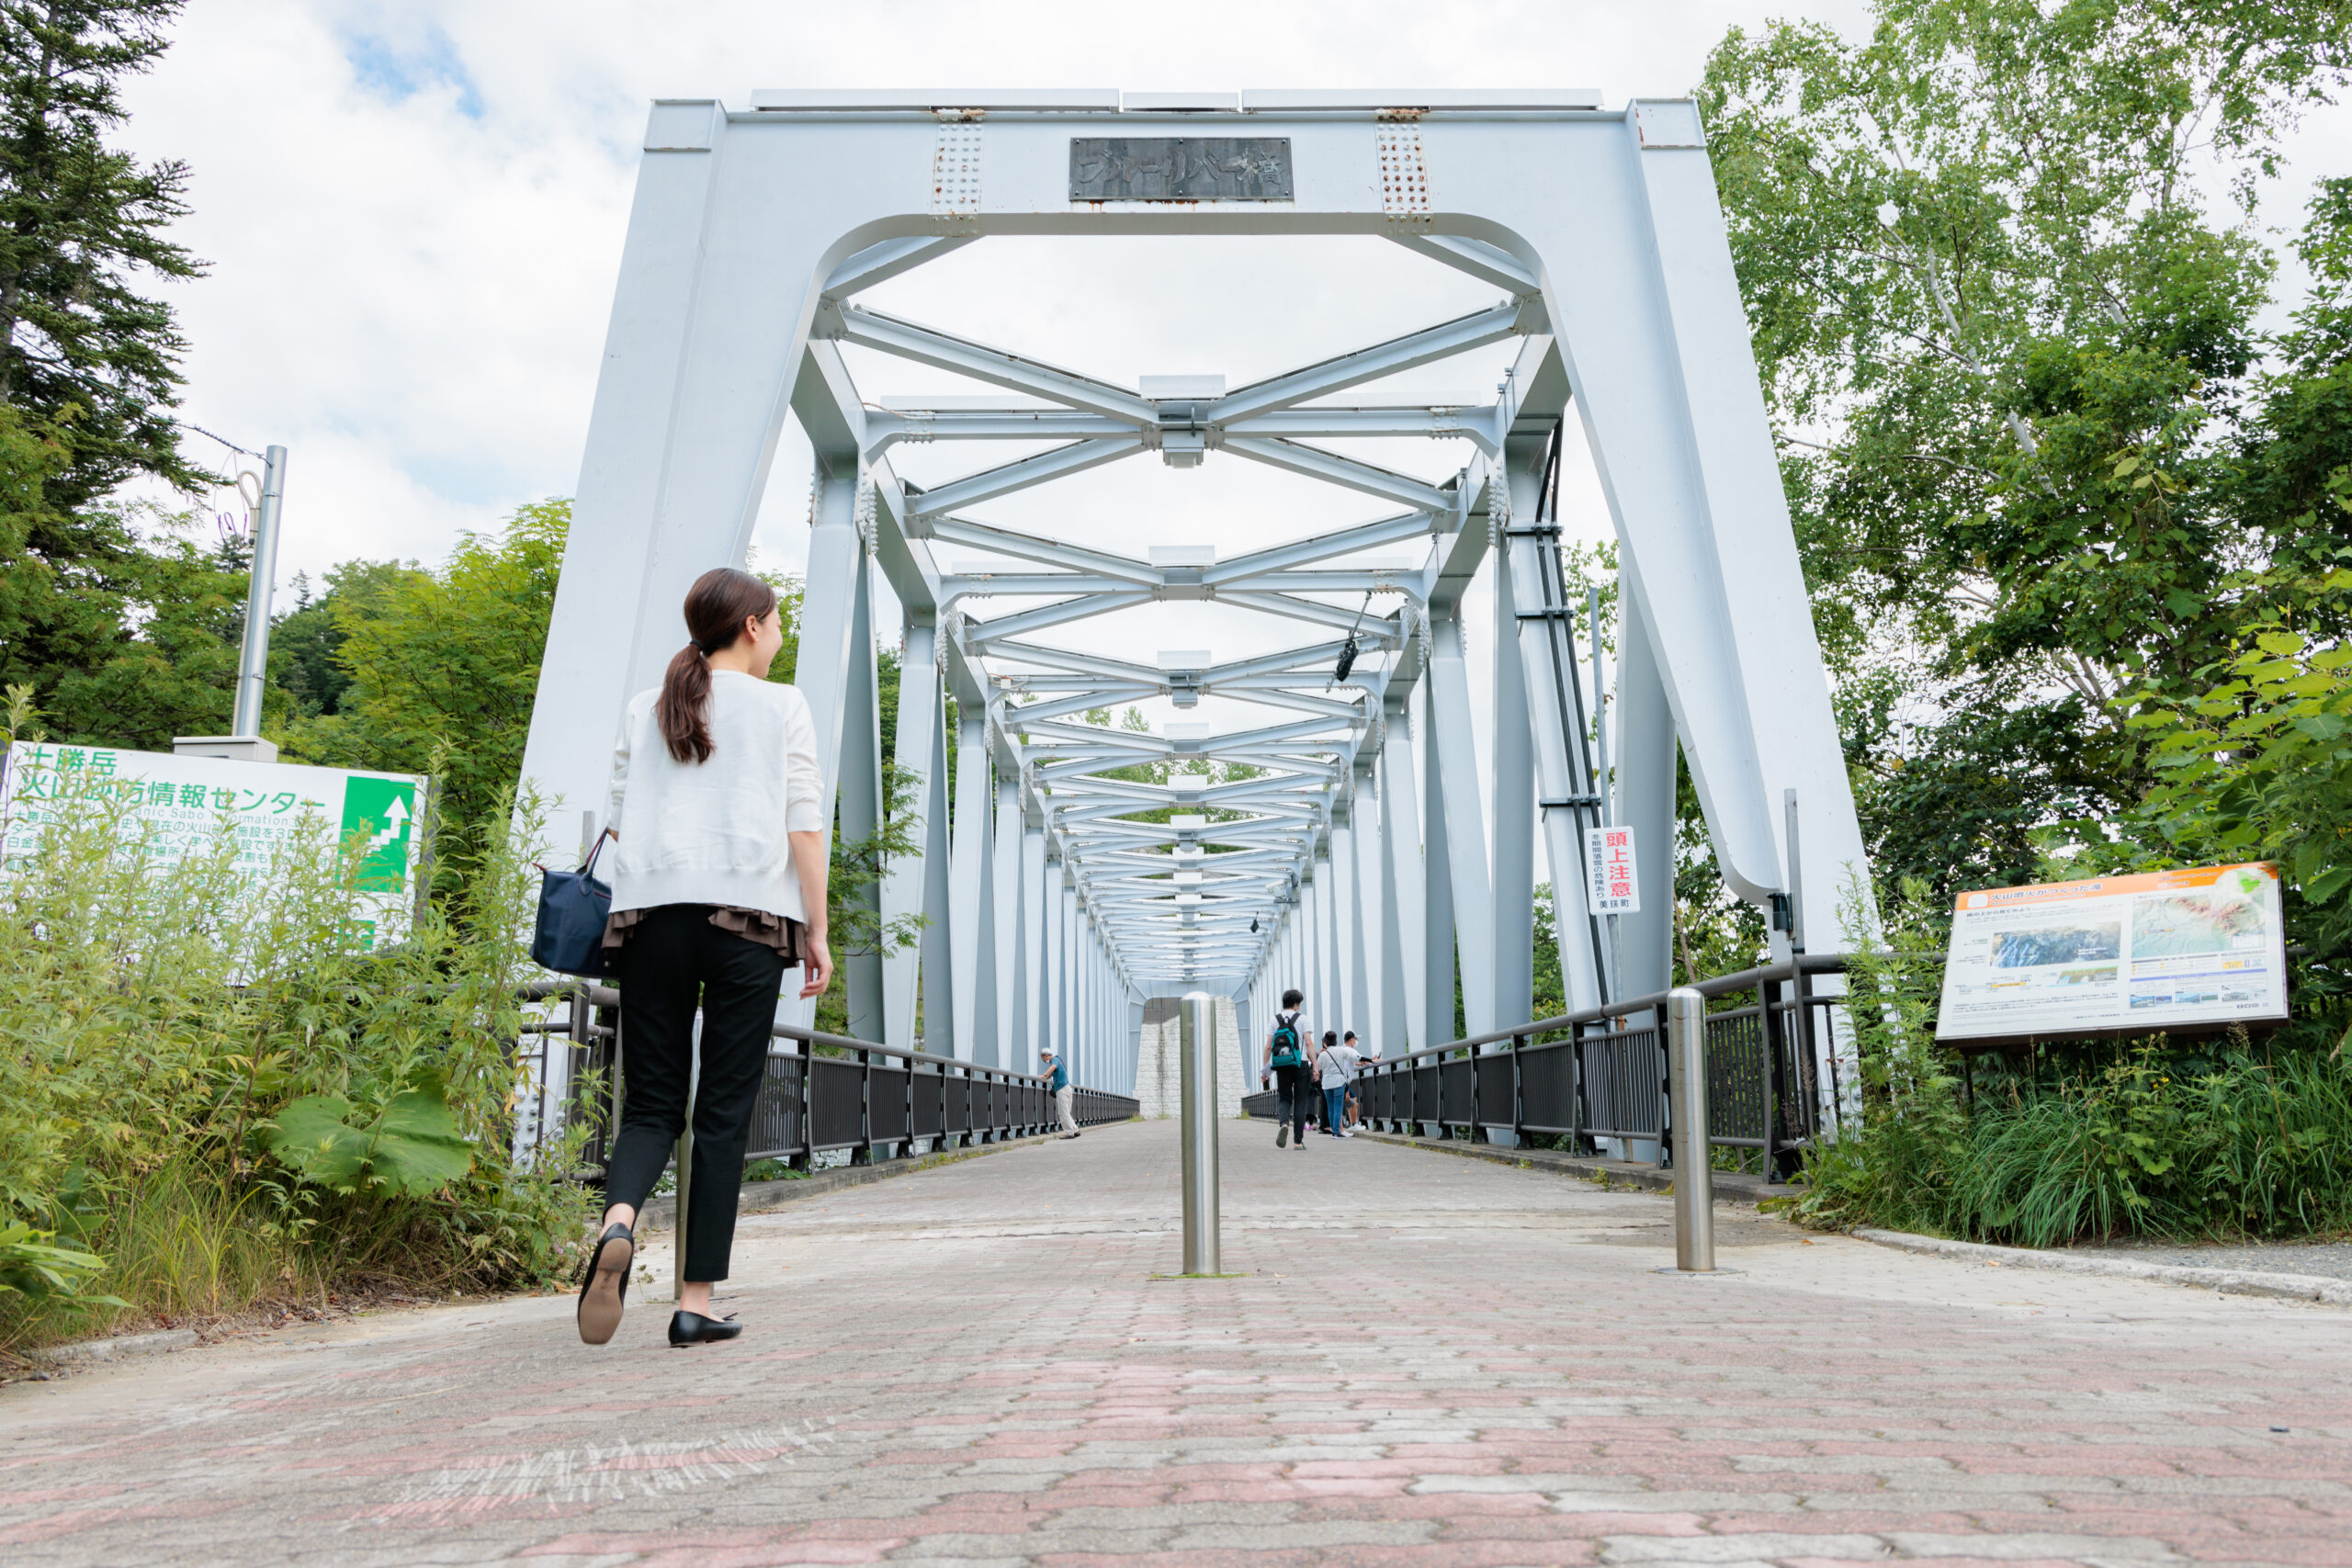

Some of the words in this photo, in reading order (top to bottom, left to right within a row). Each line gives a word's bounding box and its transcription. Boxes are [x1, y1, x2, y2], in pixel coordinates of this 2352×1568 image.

[1605, 831, 1632, 897] 頭上注意
[1600, 898, 1629, 909] 美瑛町
